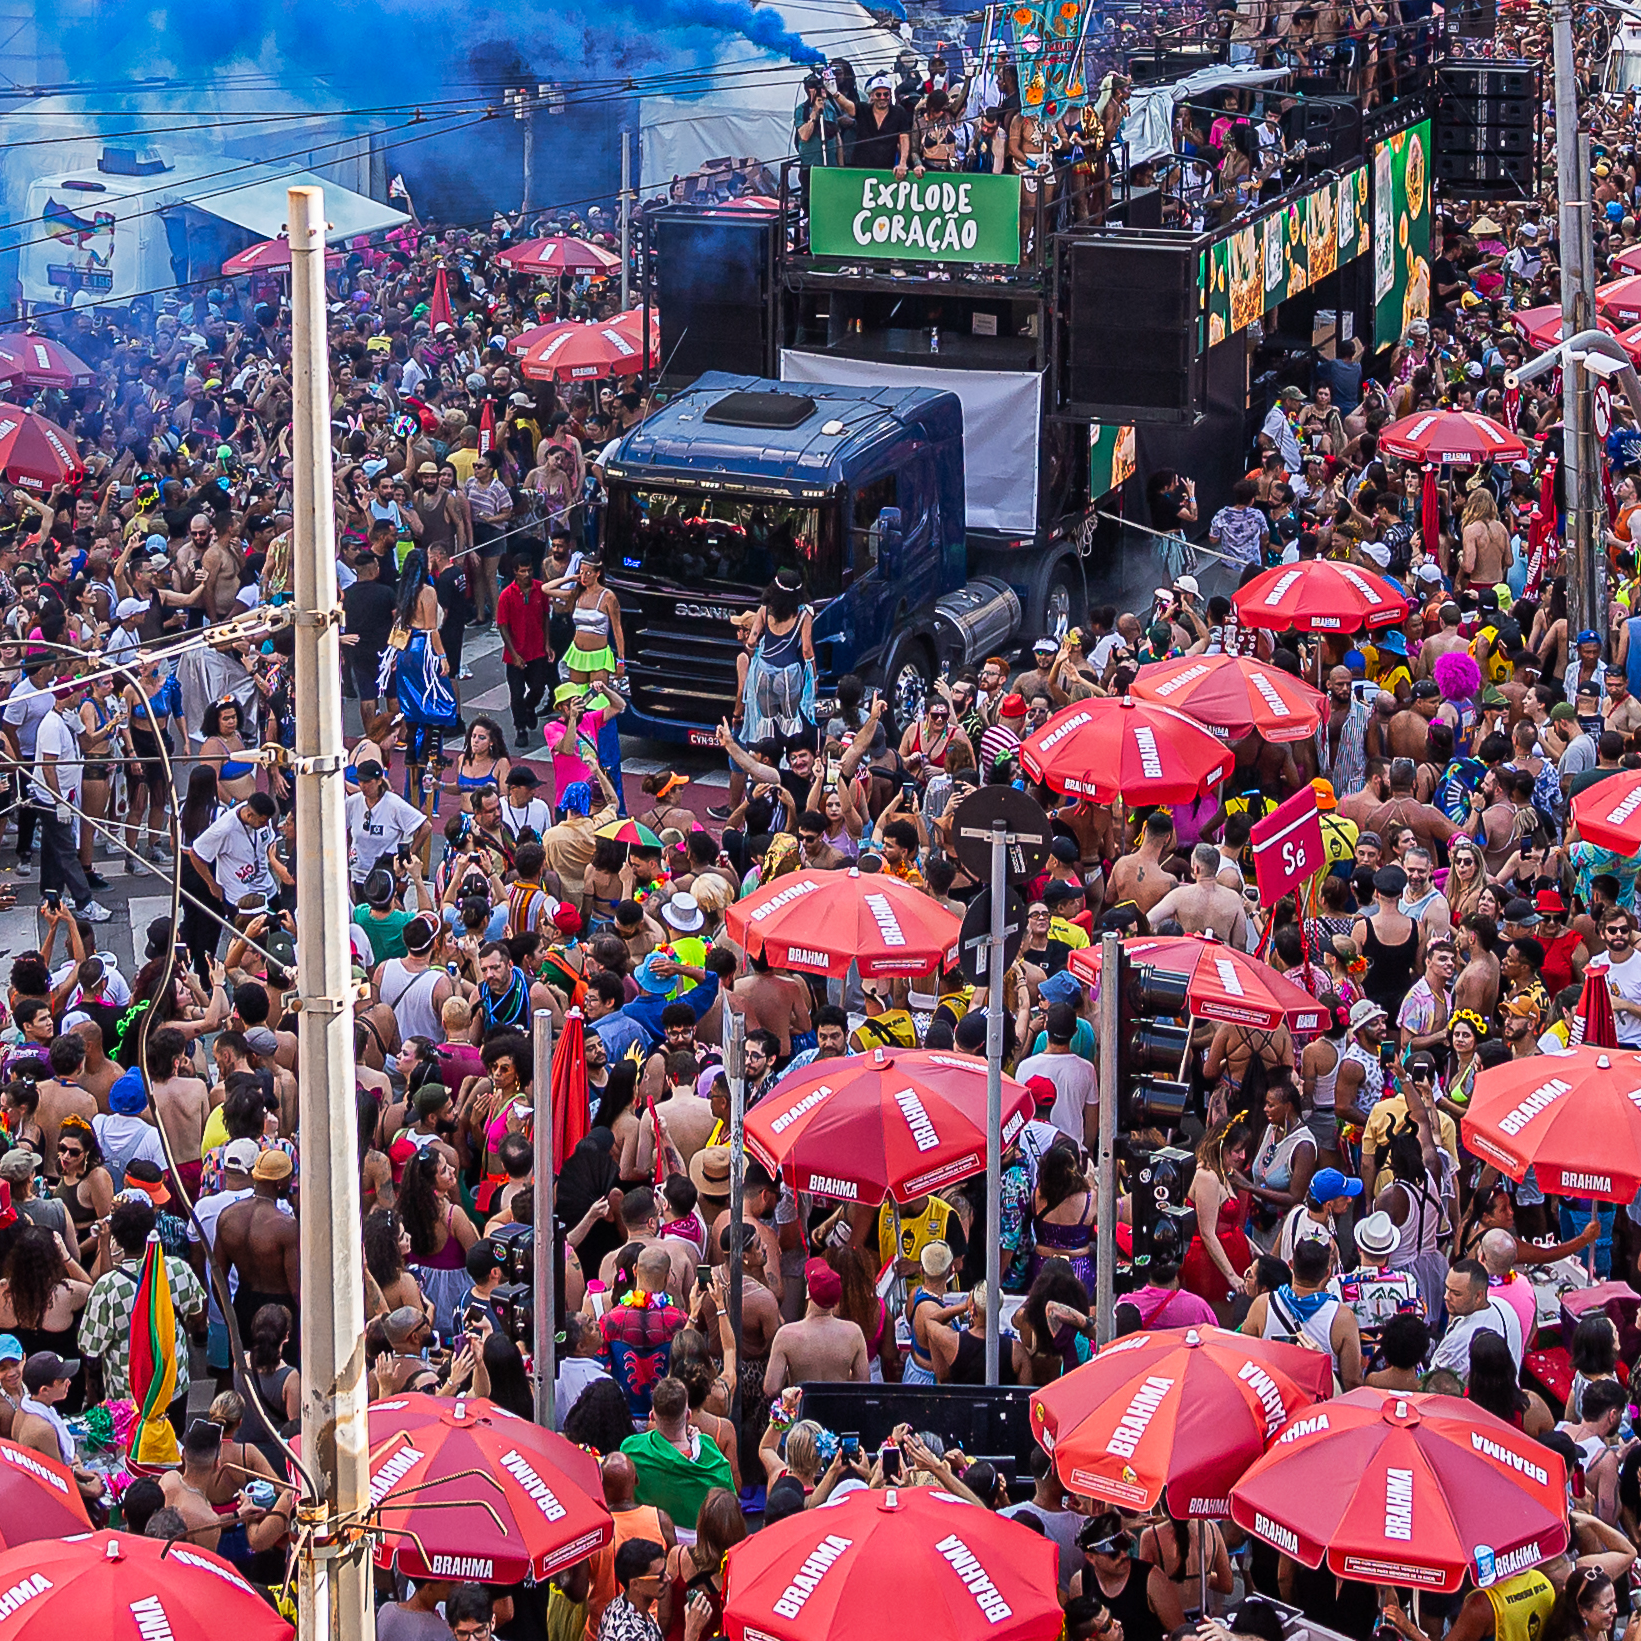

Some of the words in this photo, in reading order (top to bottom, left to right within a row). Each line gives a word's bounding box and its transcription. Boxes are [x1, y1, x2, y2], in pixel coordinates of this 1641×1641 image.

[862, 177, 973, 214] EXPLODE
[852, 210, 979, 254] CORAÇÃO
[1264, 570, 1304, 606] BRAHMA
[1343, 570, 1386, 607] BRAHMA
[1154, 664, 1211, 697] BRAHMA
[1248, 672, 1291, 716] BRAHMA
[1038, 710, 1095, 750] BRAHMA
[1133, 726, 1163, 778] BRAHMA
[1279, 838, 1307, 878] Sé
[750, 880, 820, 921] BRAHMA
[864, 893, 906, 945] BRAHMA
[787, 947, 829, 968] BRAHMA
[770, 1085, 833, 1134] BRAHMA
[894, 1087, 940, 1152] BRAHMA
[1498, 1078, 1573, 1136] BRAHMA
[808, 1174, 858, 1199] BRAHMA
[1561, 1171, 1612, 1193] BRAHMA
[1105, 1376, 1175, 1459] BRAHMA
[0, 1445, 69, 1494] BRAHMA
[1471, 1431, 1548, 1486] BRAHMA
[500, 1447, 570, 1523] BRAHMA
[1188, 1498, 1229, 1514] BRAHMA
[1384, 1467, 1413, 1541] BRAHMA
[1255, 1512, 1303, 1553] BRAHMA
[433, 1552, 496, 1578] BRAHMA
[772, 1534, 853, 1619] BRAHMA
[935, 1534, 1012, 1624] BRAHMA
[1495, 1539, 1542, 1578] BRAHMA
